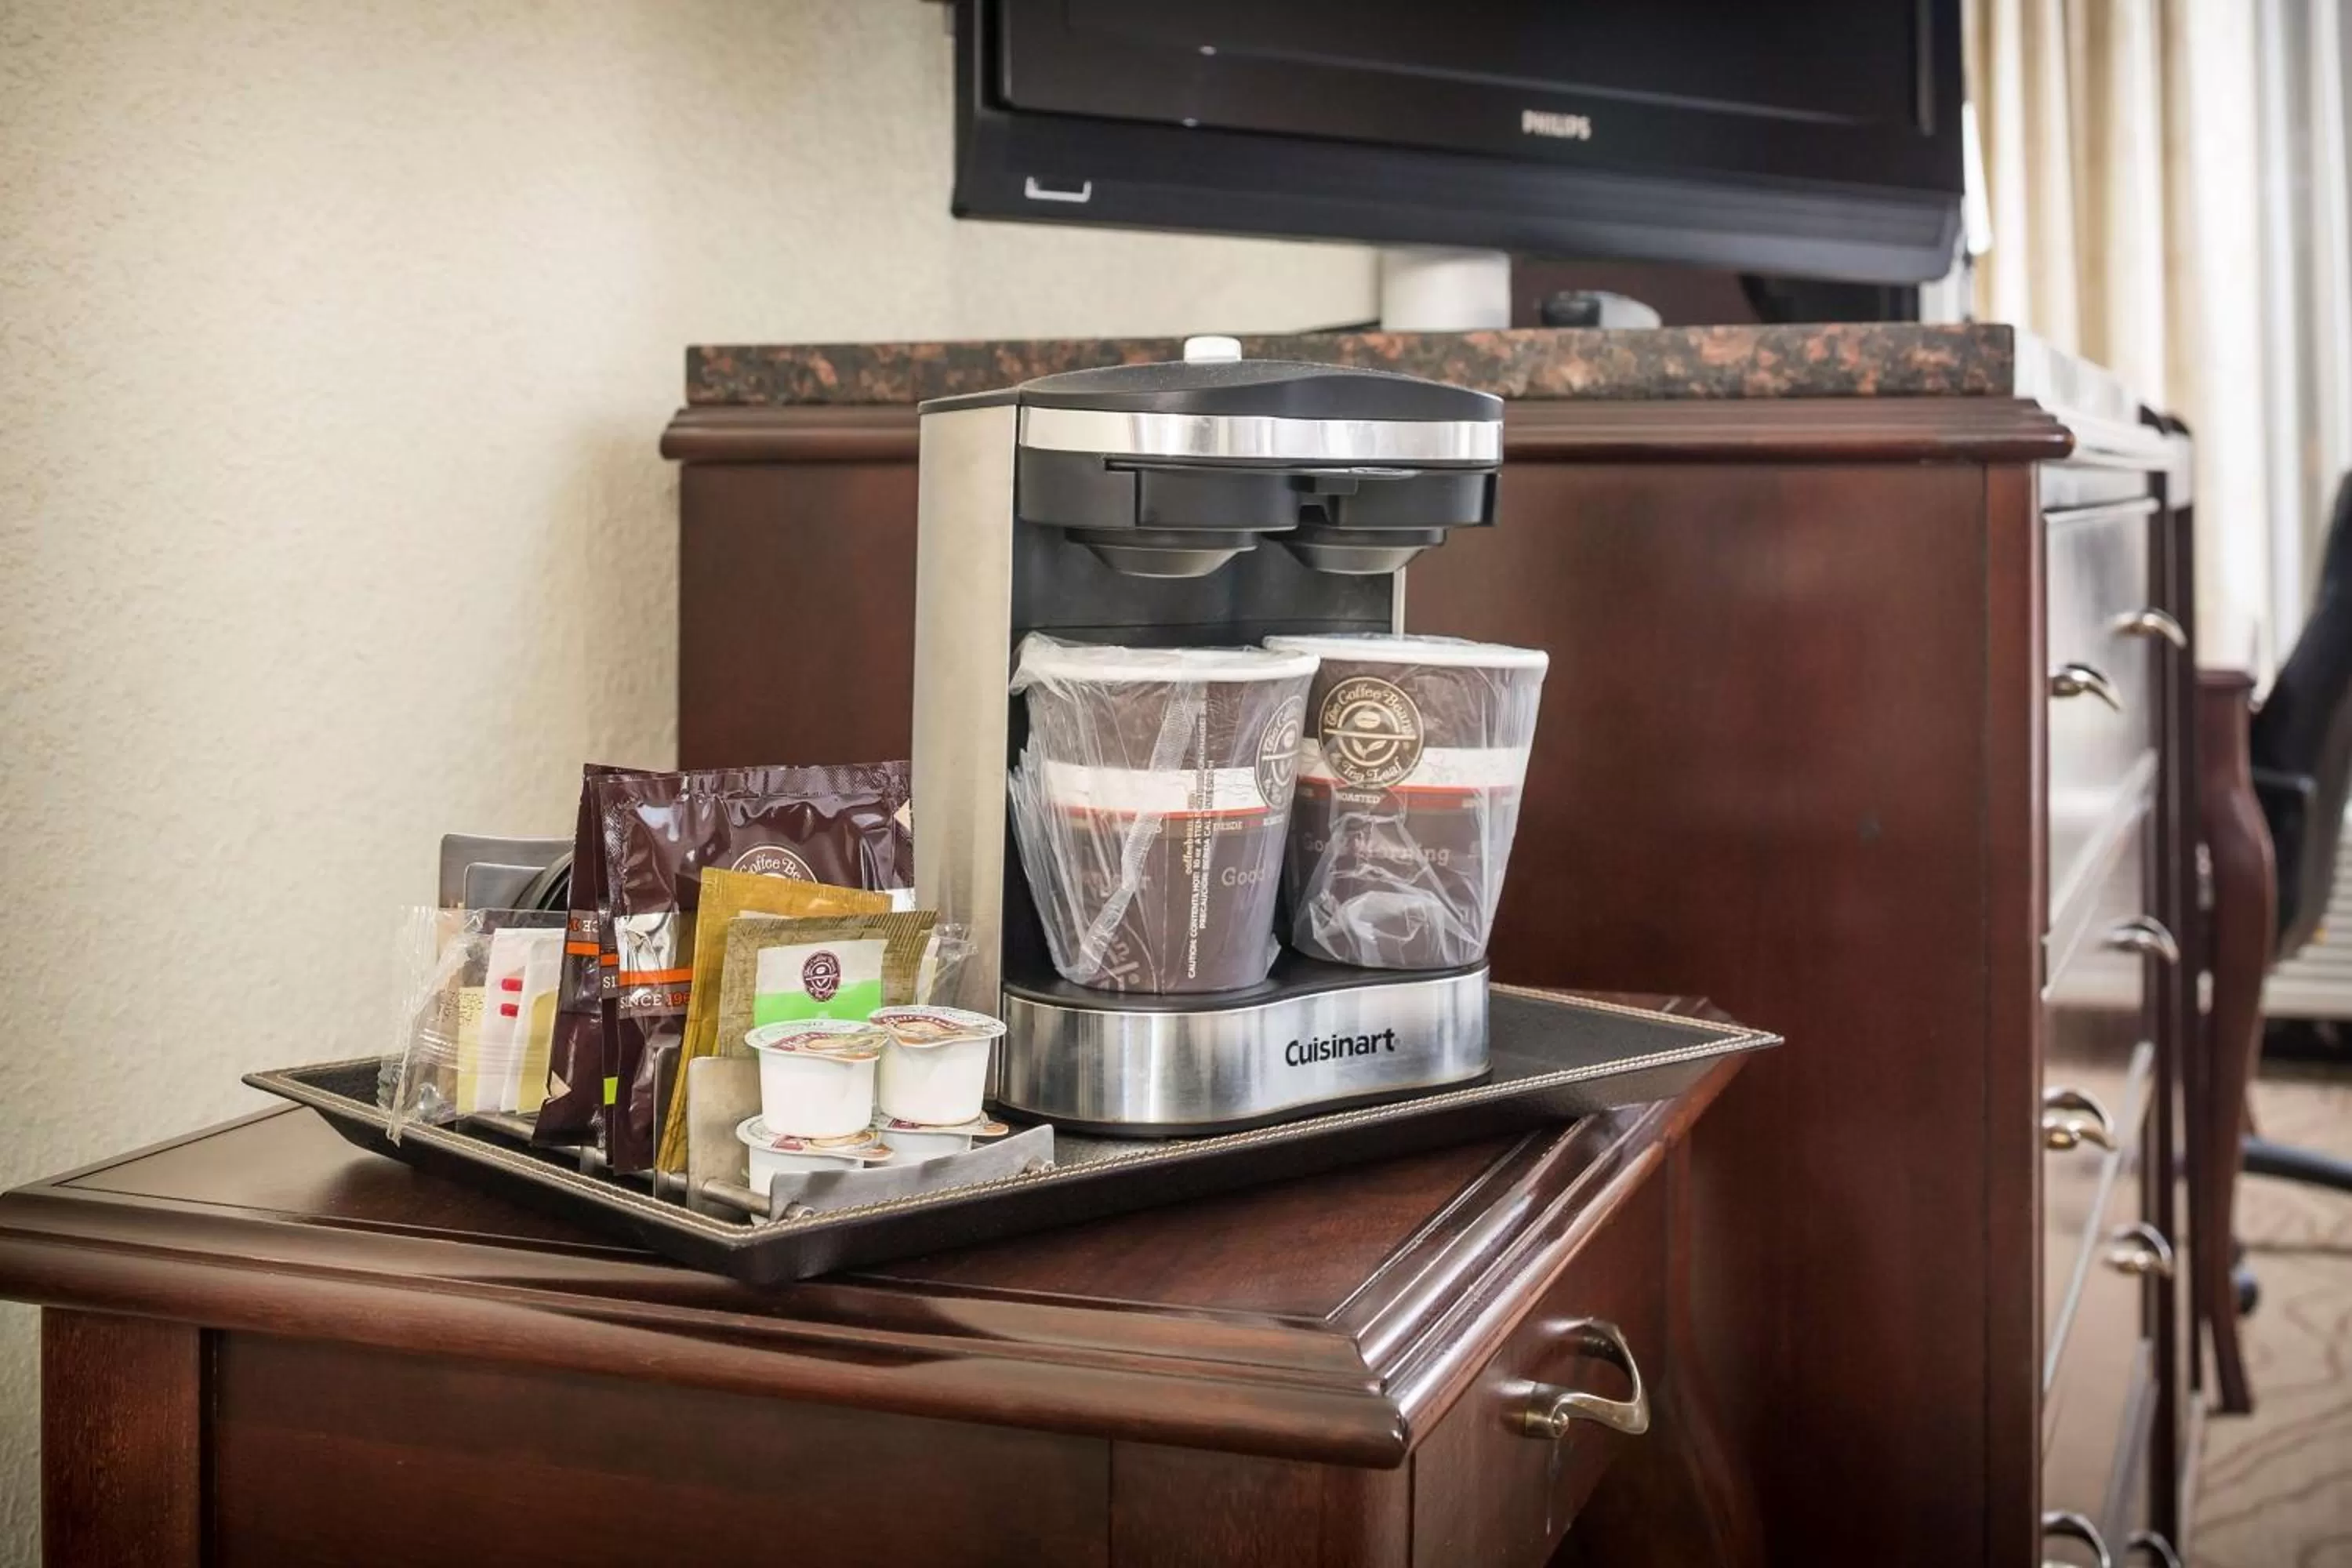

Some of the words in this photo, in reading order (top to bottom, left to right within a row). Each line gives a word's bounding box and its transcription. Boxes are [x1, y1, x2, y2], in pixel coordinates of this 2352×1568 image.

[1522, 109, 1592, 140] PHILIPS
[1324, 704, 1341, 727] The
[1337, 683, 1382, 705] Coffee
[1382, 688, 1412, 727] Bean
[1341, 760, 1366, 782] Tea
[1367, 756, 1403, 782] Leaf
[1285, 1028, 1396, 1067] Cuisinart
